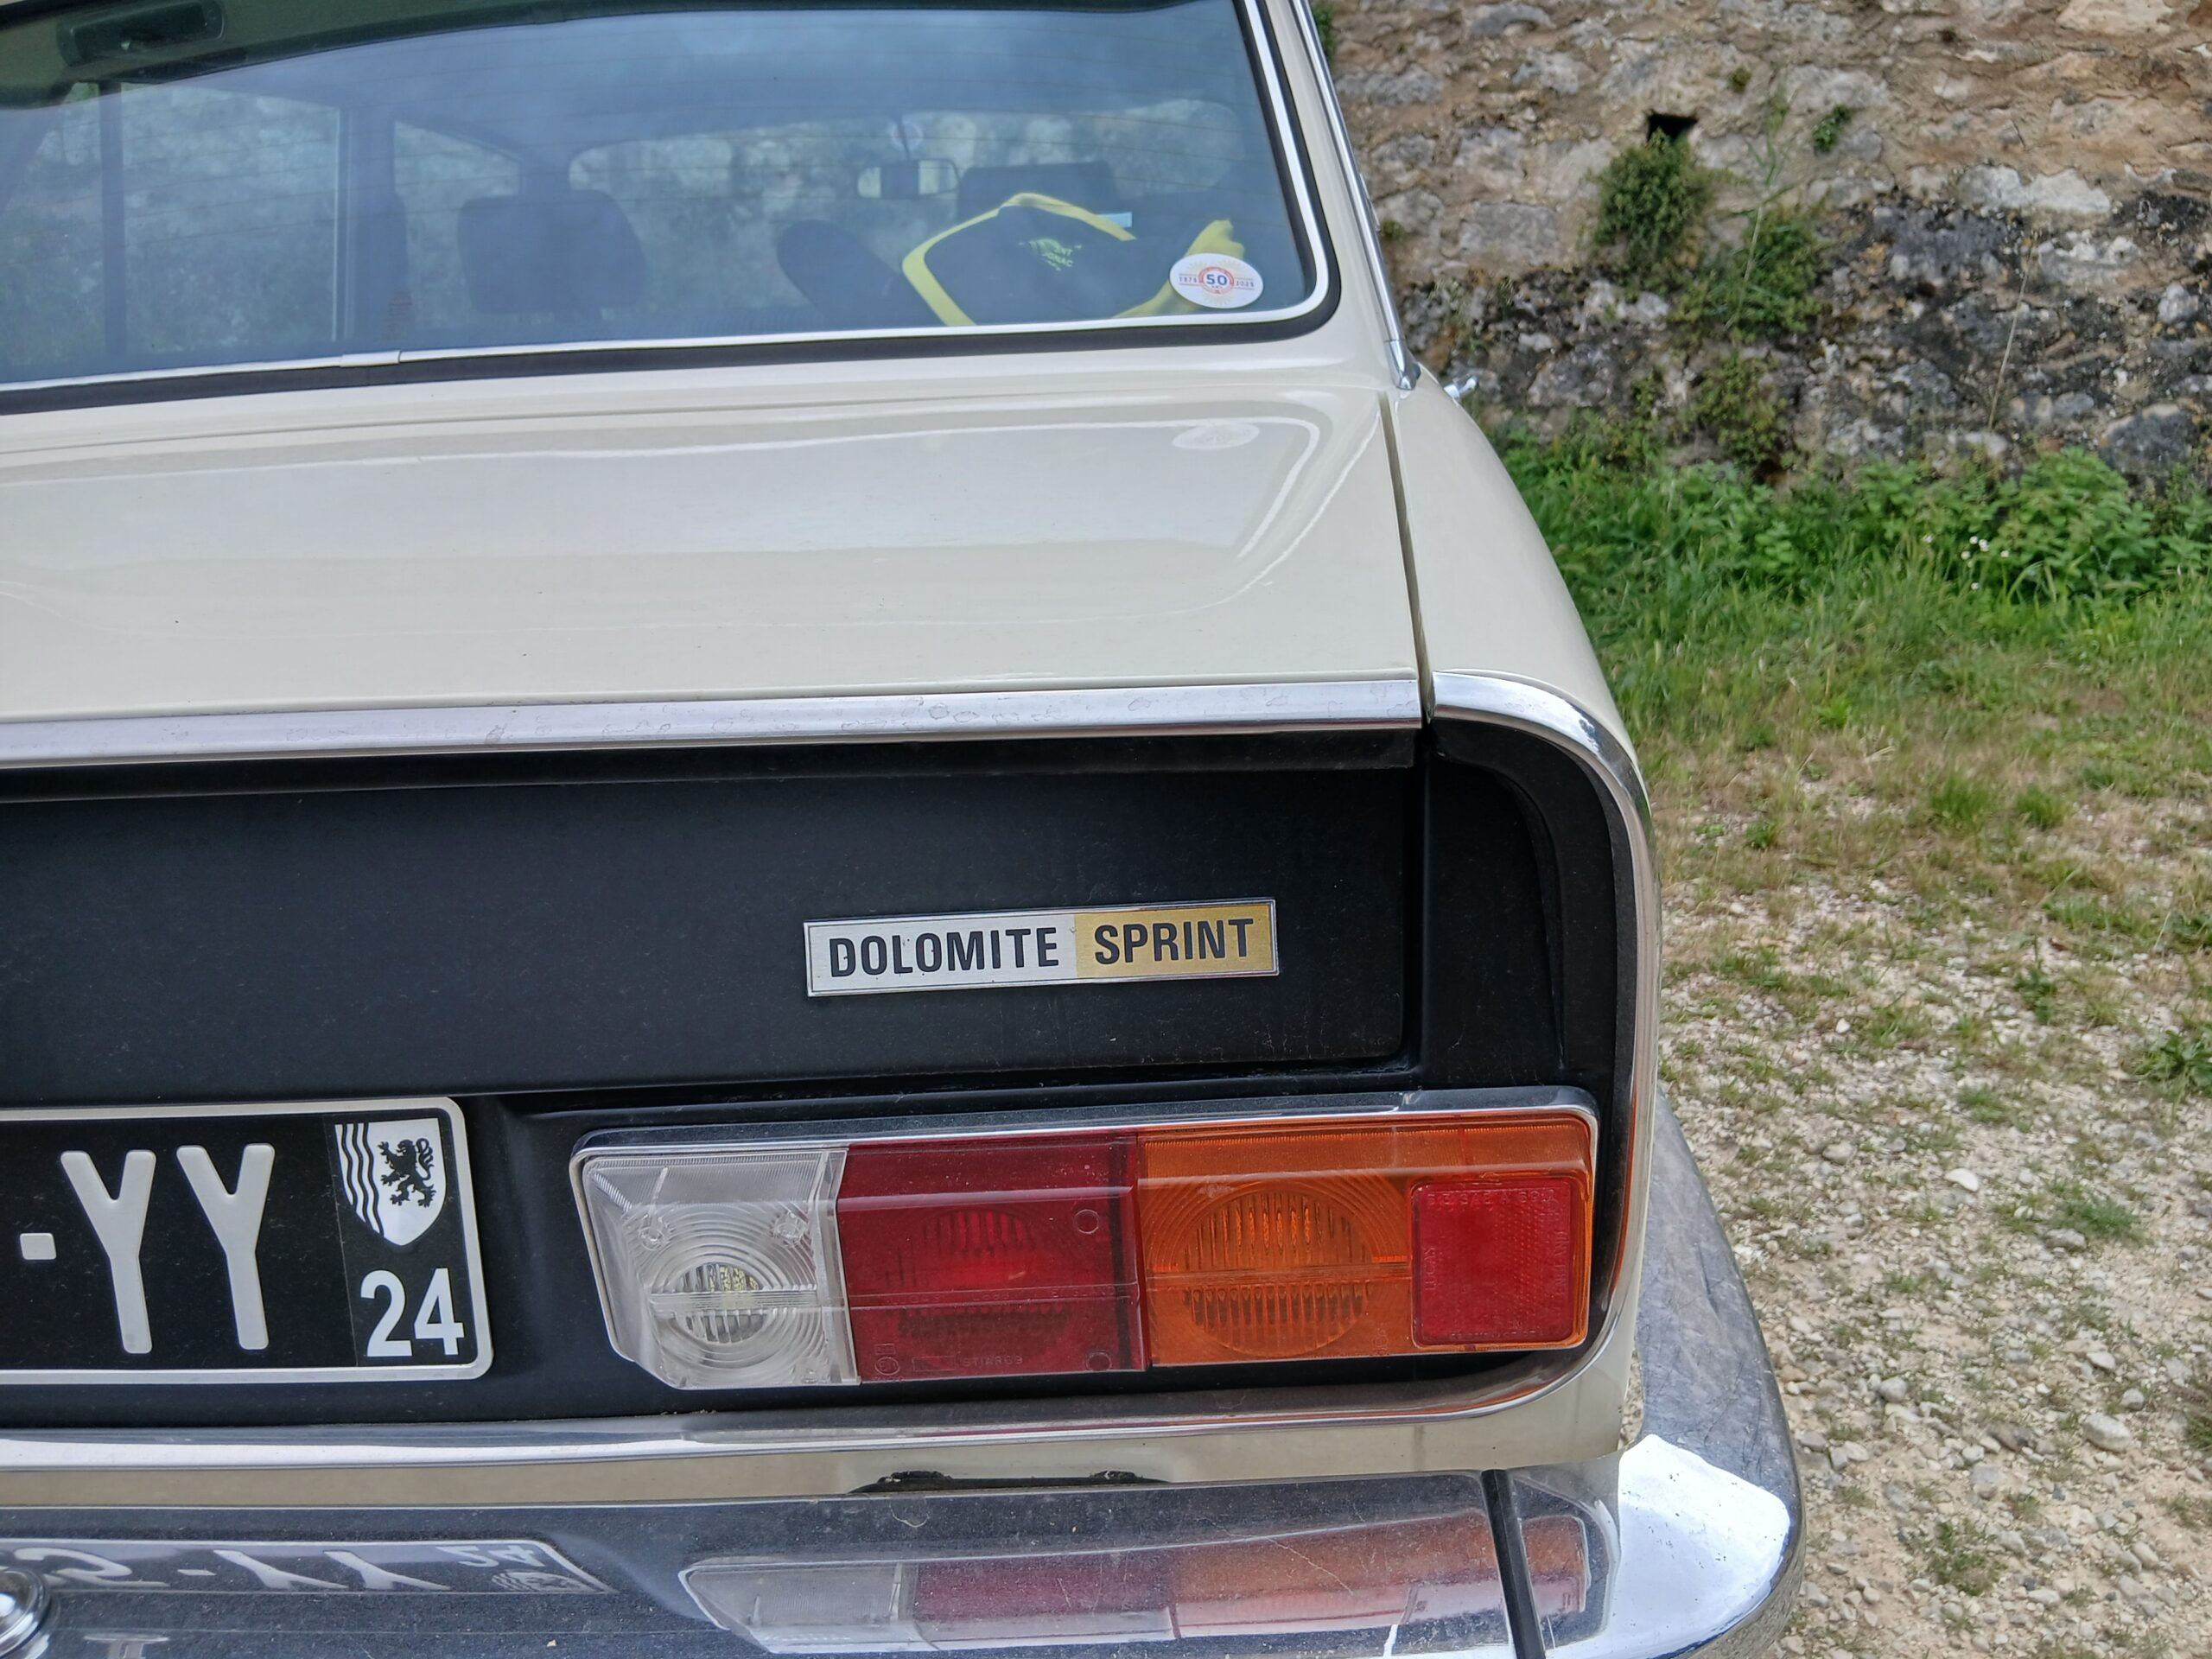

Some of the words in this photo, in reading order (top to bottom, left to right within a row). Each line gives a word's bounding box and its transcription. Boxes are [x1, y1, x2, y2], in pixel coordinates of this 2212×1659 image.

[1206, 274, 1228, 286] 50
[829, 926, 1059, 978] DOLOMITE
[1094, 918, 1254, 966] SPRINT
[360, 1268, 465, 1357] 24
